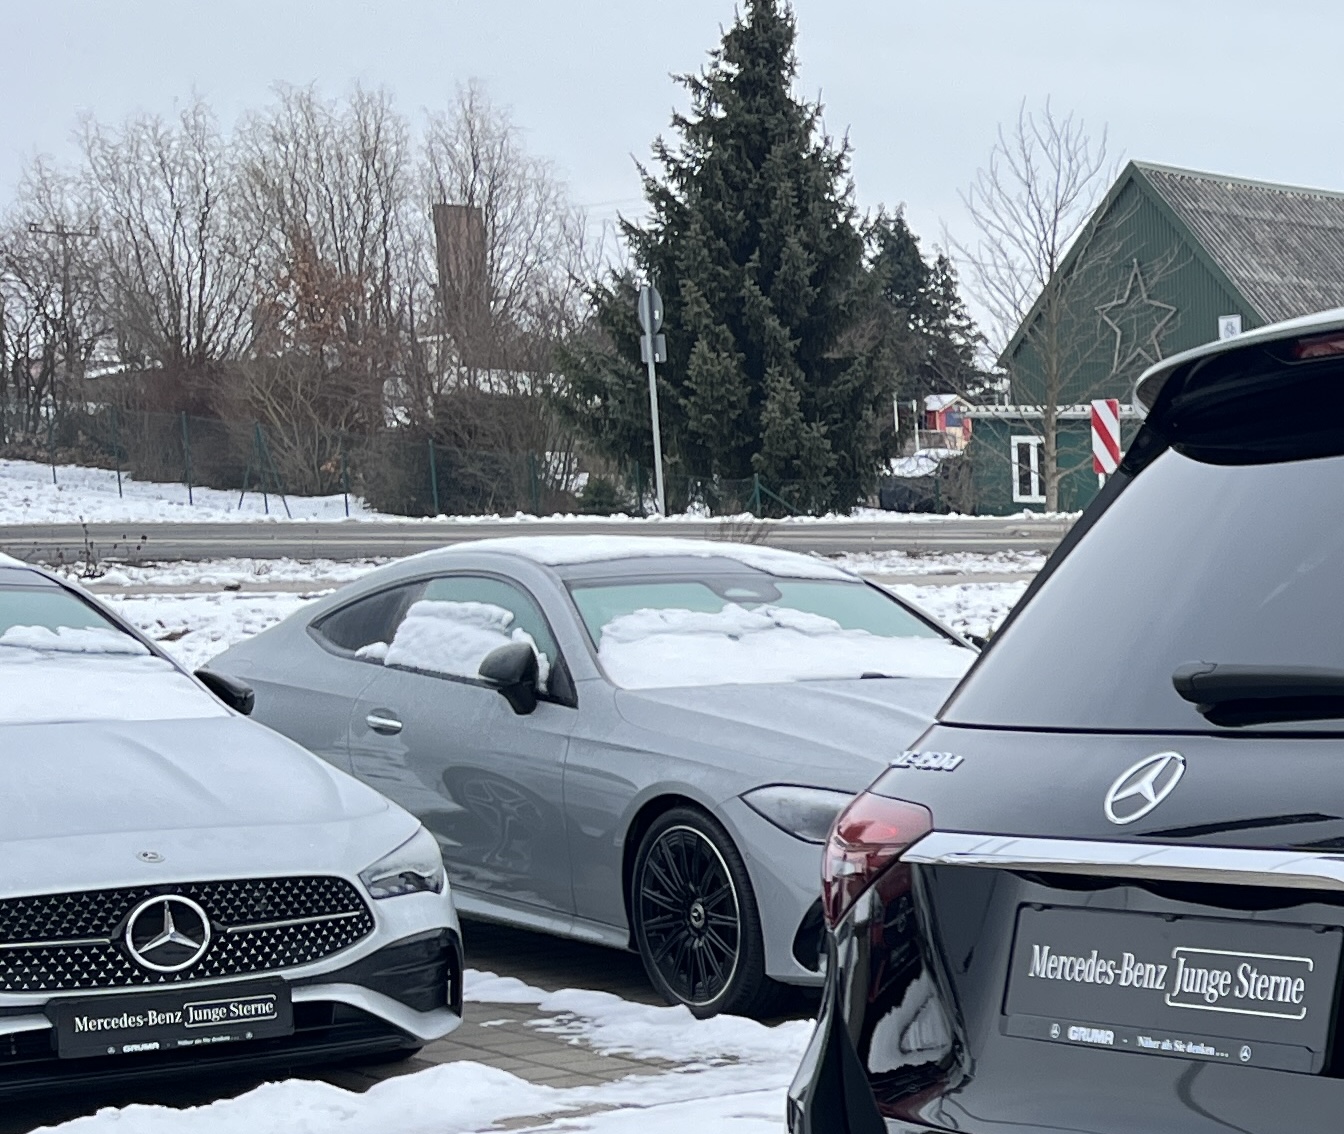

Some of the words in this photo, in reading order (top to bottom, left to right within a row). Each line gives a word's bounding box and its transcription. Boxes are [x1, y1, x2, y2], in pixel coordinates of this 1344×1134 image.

[1028, 944, 1168, 990] Mercedes-Benz
[1171, 957, 1231, 1003] Junge
[1234, 962, 1305, 1004] Sterne
[74, 1009, 183, 1033] Mercedes-Benz
[187, 1006, 227, 1024] Junge
[229, 1001, 274, 1018] Sterne
[1067, 1025, 1115, 1045] GRUMA
